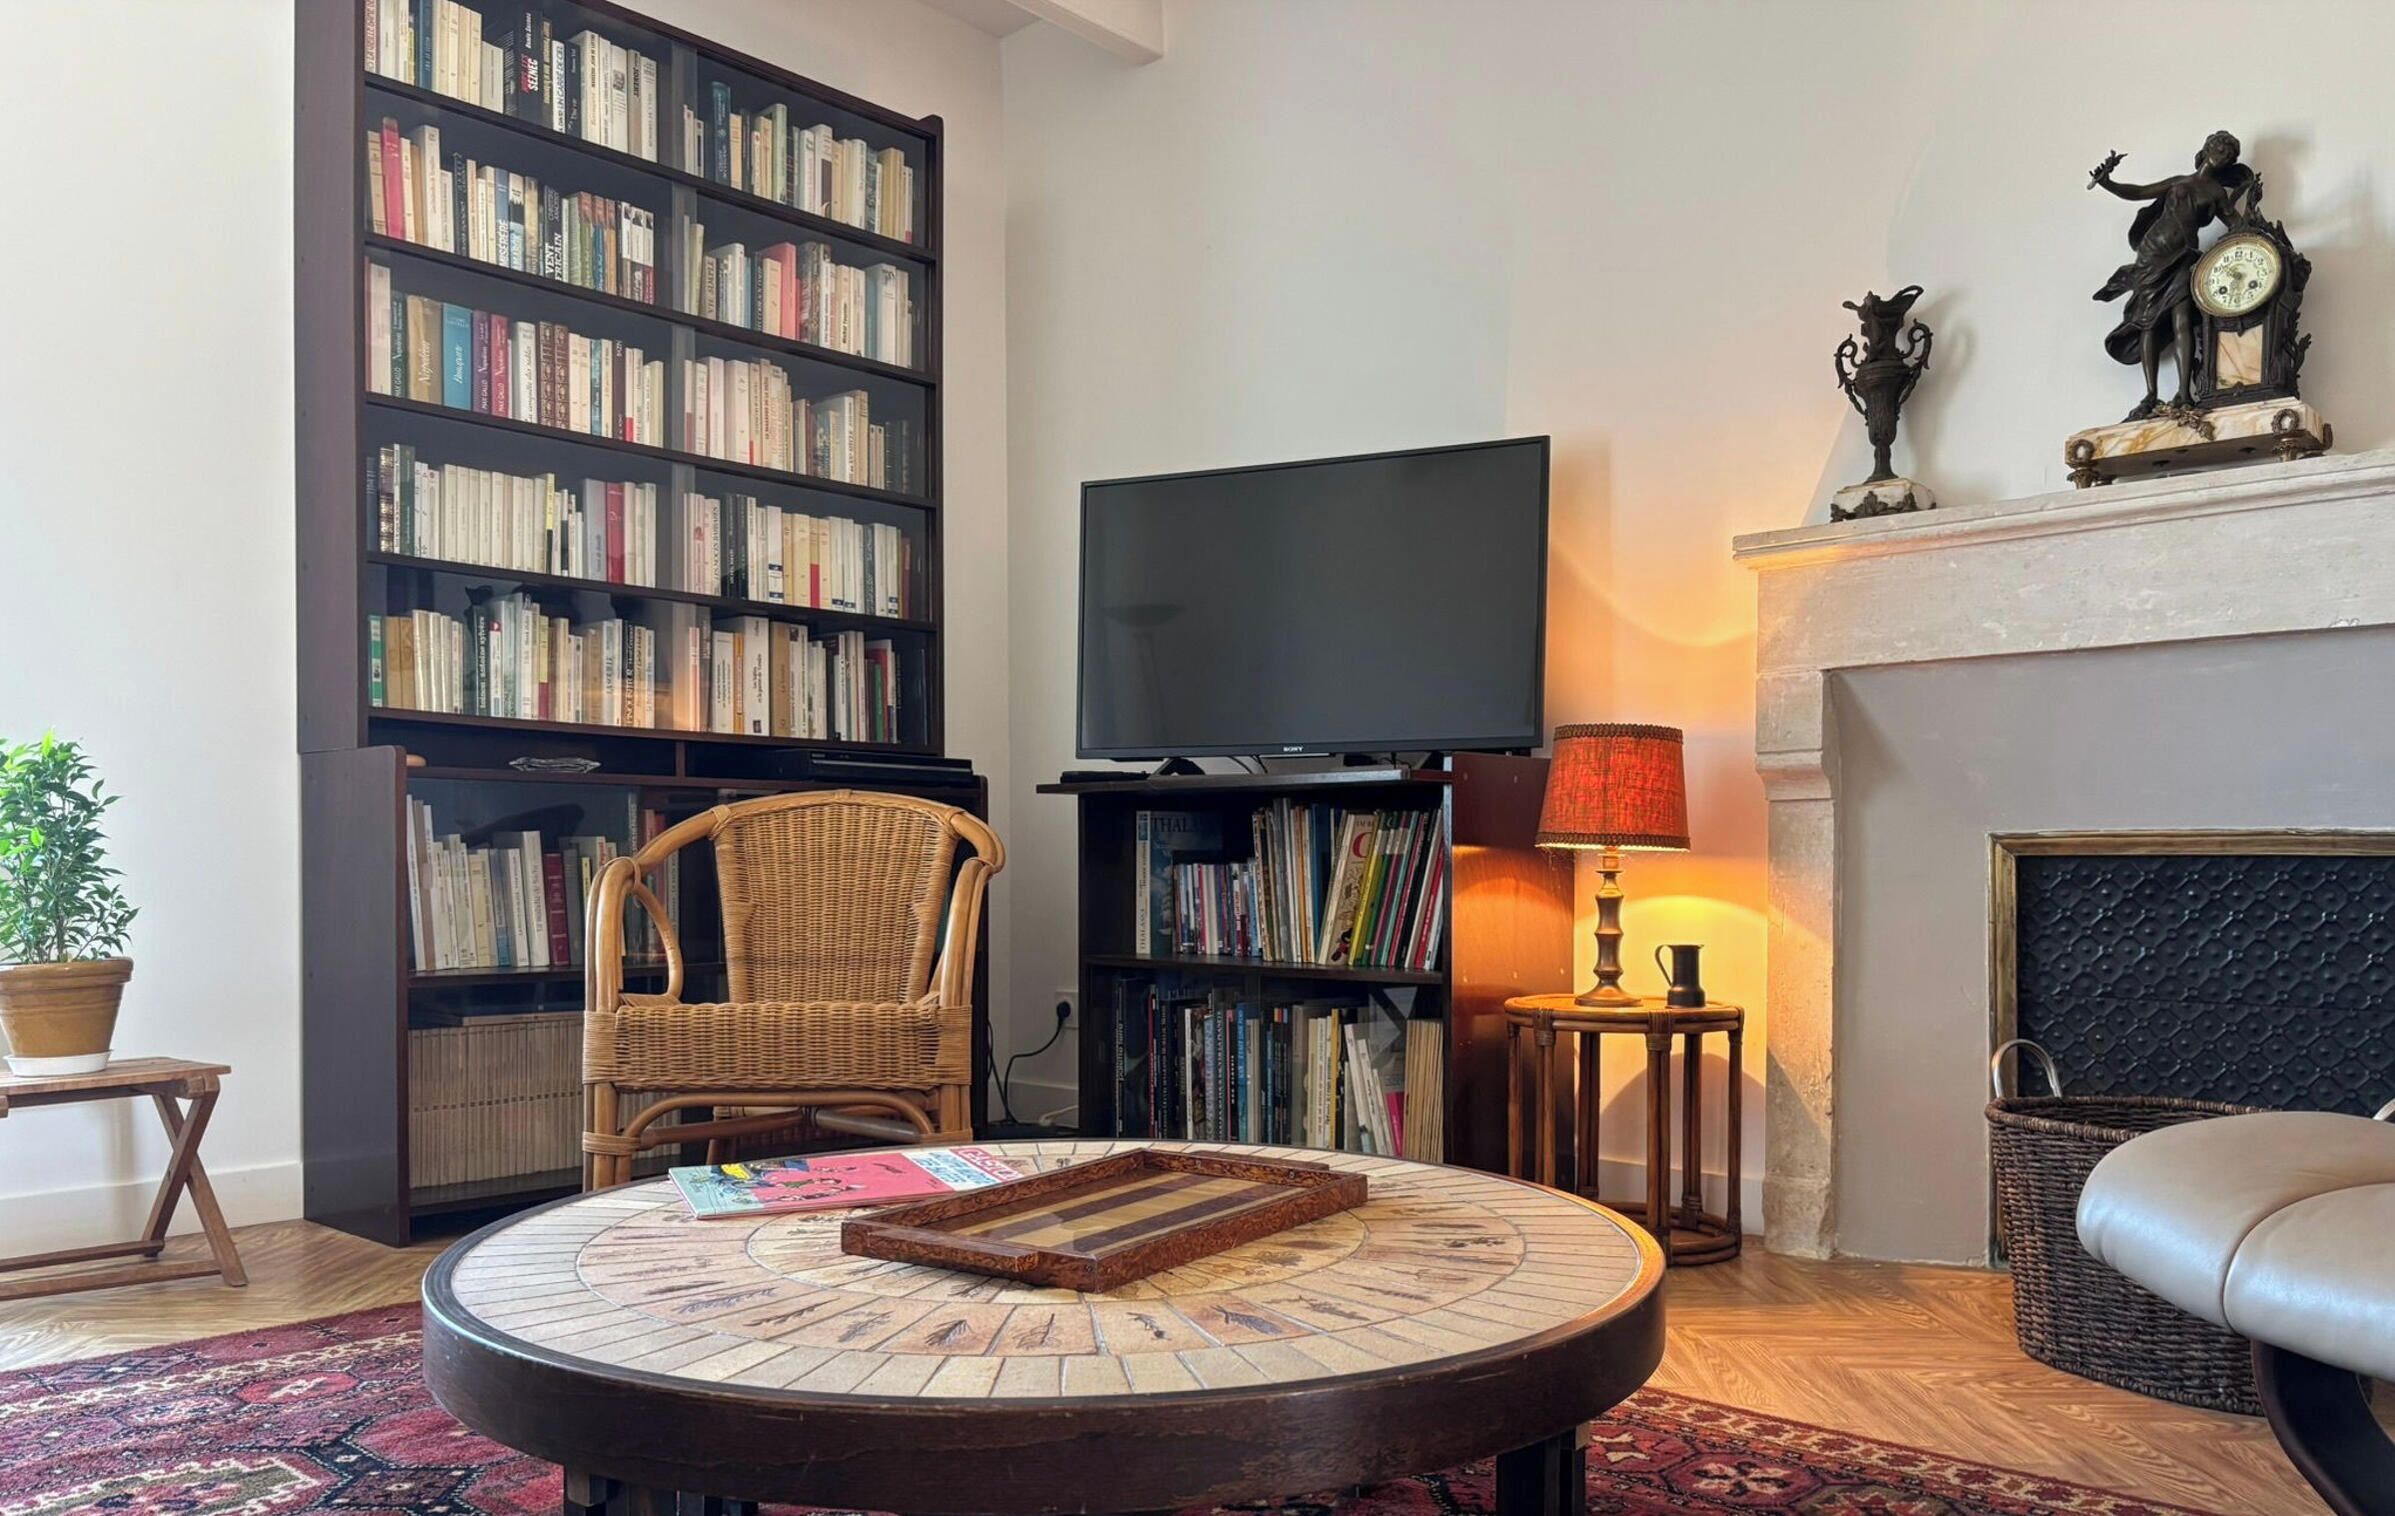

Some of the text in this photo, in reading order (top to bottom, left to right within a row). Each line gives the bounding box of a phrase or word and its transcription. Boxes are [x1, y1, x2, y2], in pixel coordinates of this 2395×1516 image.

[528, 58, 538, 91] SEZNEC
[545, 242, 553, 274] VENT
[1151, 816, 1191, 833] THAL
